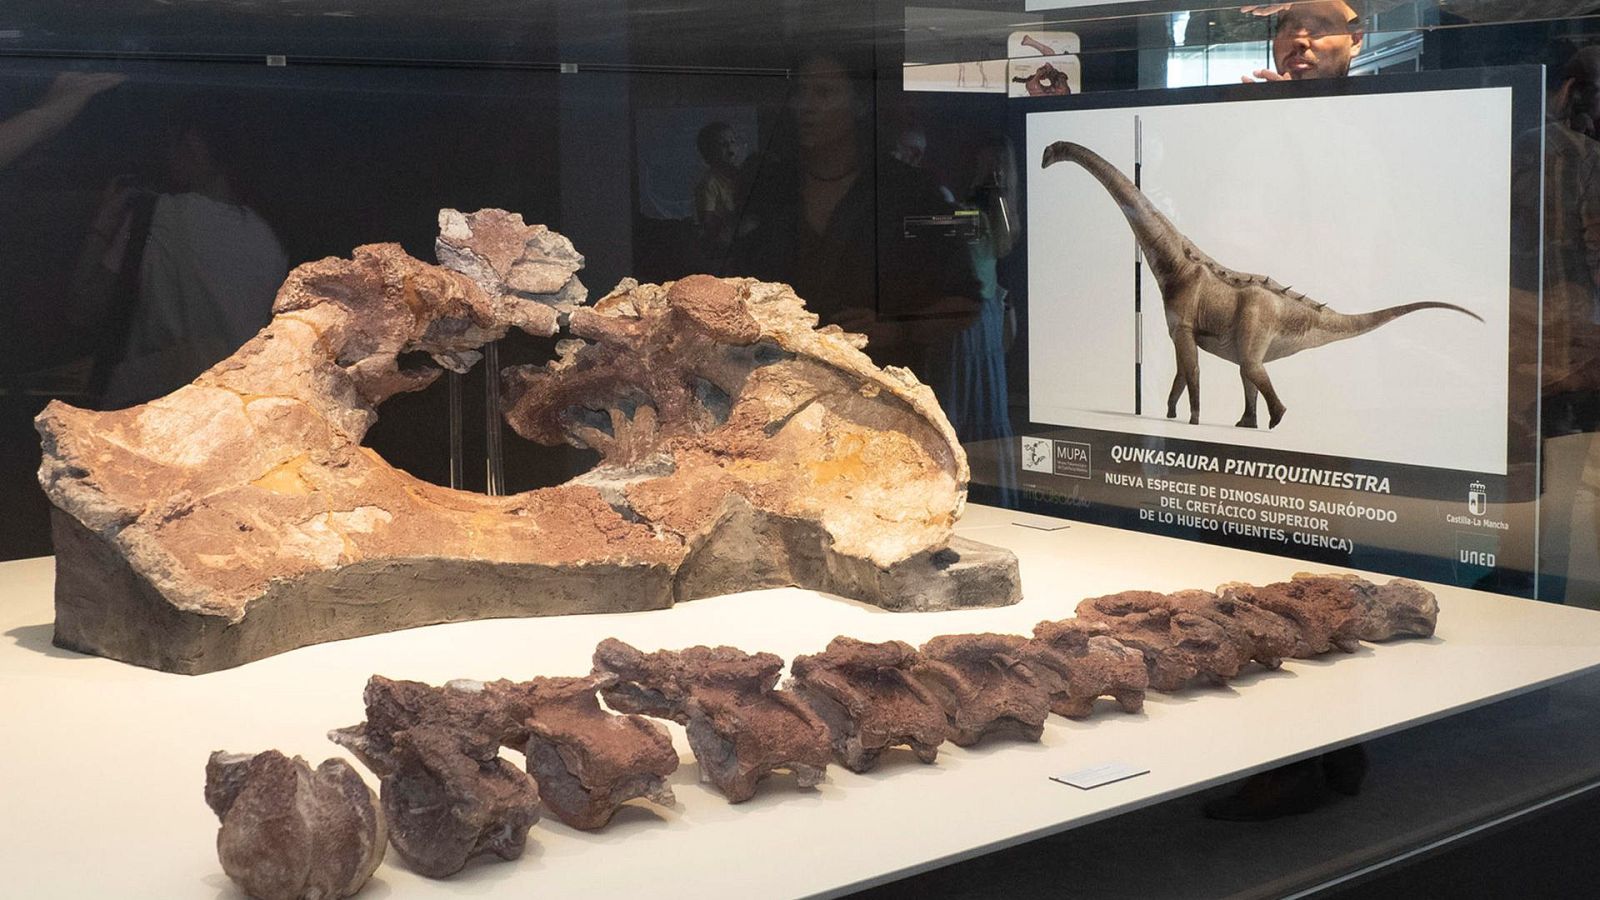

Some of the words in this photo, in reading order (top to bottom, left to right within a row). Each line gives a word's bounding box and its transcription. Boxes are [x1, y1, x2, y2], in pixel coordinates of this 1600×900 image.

[1057, 446, 1087, 461] MUPA
[1111, 445, 1219, 473] QUNKASAURA
[1224, 458, 1391, 494] PINTIQUINIESTRA
[1105, 472, 1144, 488] NUEVA
[1147, 478, 1197, 496] ESPECIE
[1200, 485, 1217, 498] DE
[1219, 488, 1305, 511] DINOSAURIO
[1308, 500, 1398, 524] SAURÓPODO
[1160, 496, 1183, 510] DEL
[1186, 500, 1257, 521] CRETÁCICO
[1260, 510, 1329, 531] SUPERIOR
[1139, 508, 1155, 521] DE
[1158, 511, 1174, 524] LO
[1177, 514, 1219, 531] HUECO
[1222, 520, 1289, 544] (FUENTES,
[1292, 531, 1353, 555] CUENCA)
[1446, 513, 1481, 526] Castilla-La
[1483, 518, 1509, 530] Mancha
[1460, 549, 1495, 567] UNED
